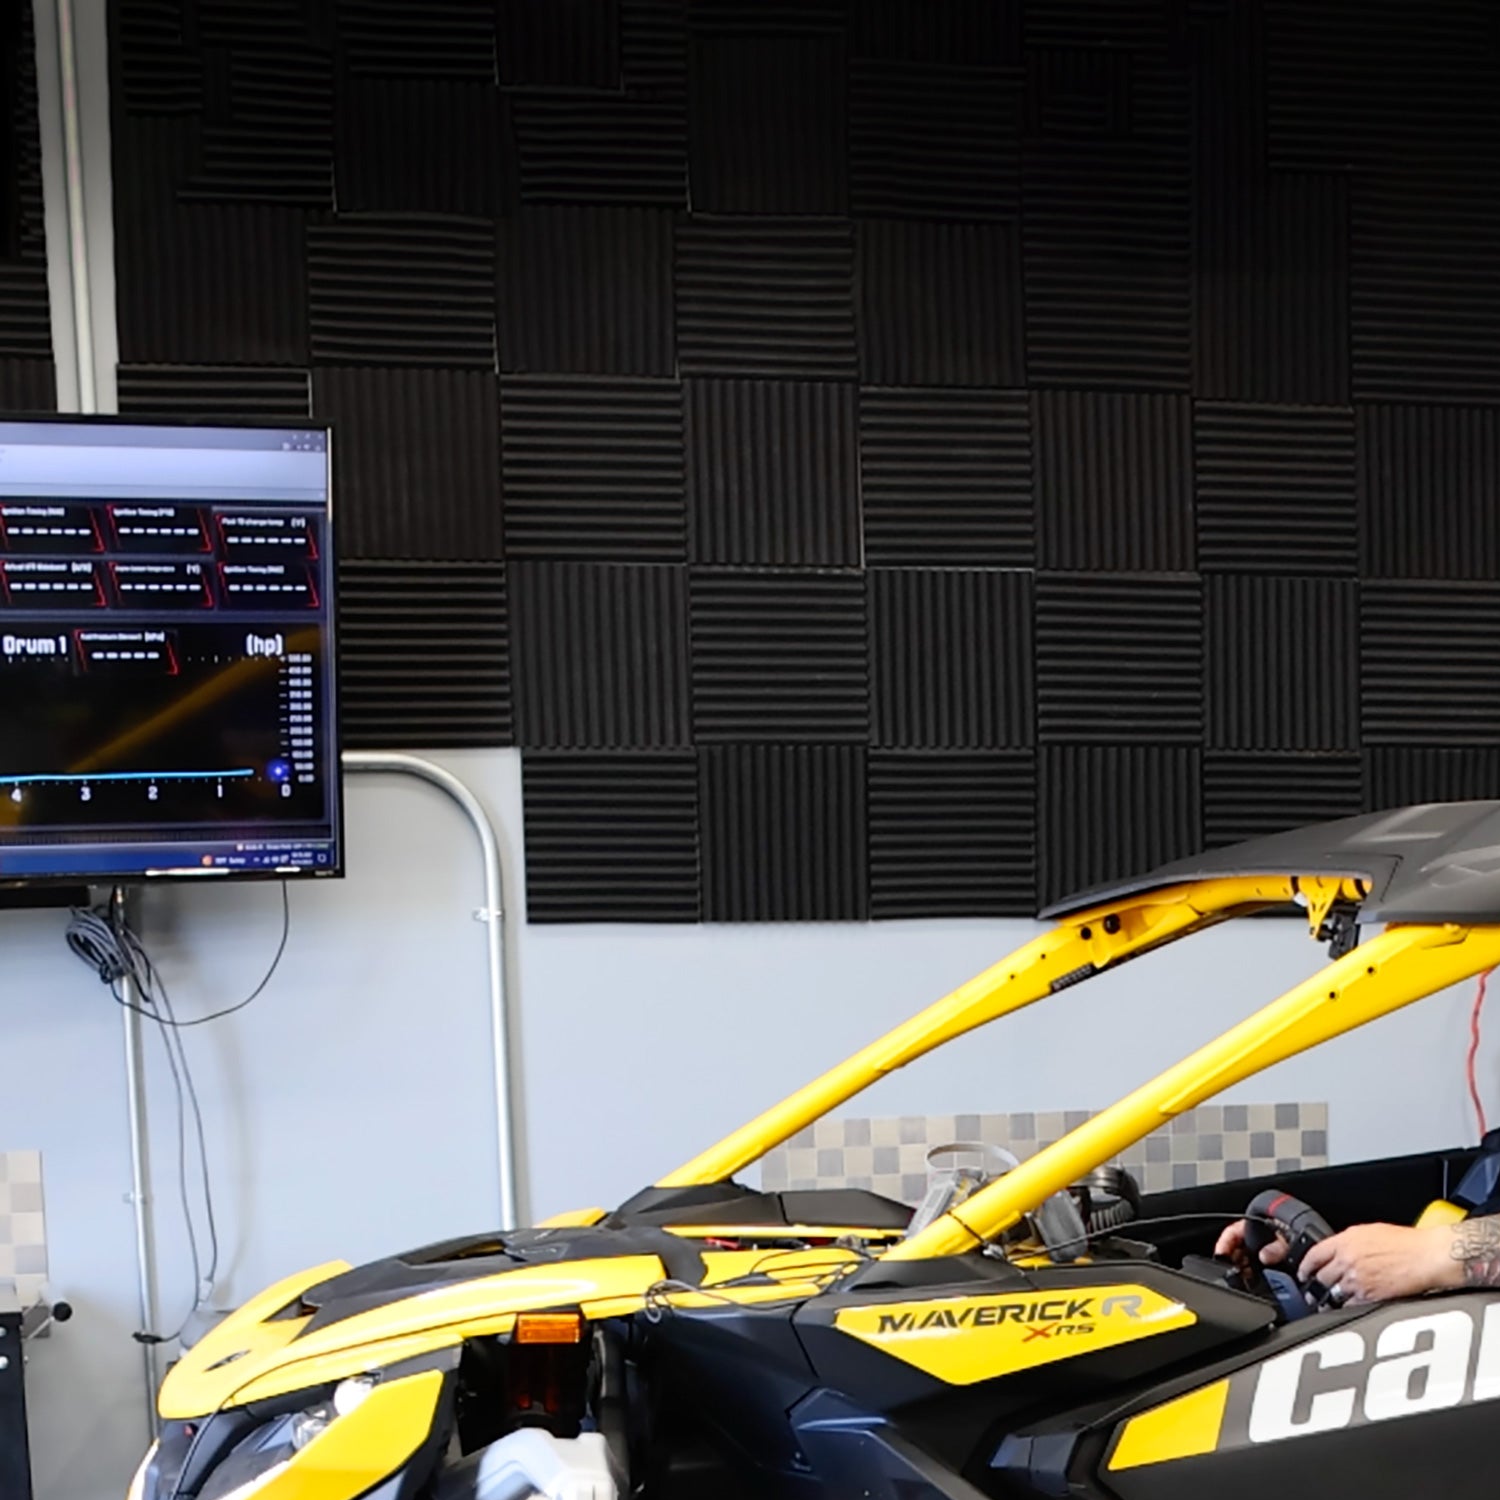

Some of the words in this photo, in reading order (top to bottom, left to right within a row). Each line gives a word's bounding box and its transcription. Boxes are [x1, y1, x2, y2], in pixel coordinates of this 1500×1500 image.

[3, 635, 55, 655] Drum
[59, 635, 67, 654] 1
[246, 633, 283, 657] (hp)
[11, 788, 22, 803] 4
[80, 786, 91, 801] 3
[148, 786, 158, 800] 2
[217, 785, 223, 798] 1
[281, 783, 292, 798] 0
[878, 1297, 1095, 1334] MAVERICK
[1101, 1294, 1143, 1318] R
